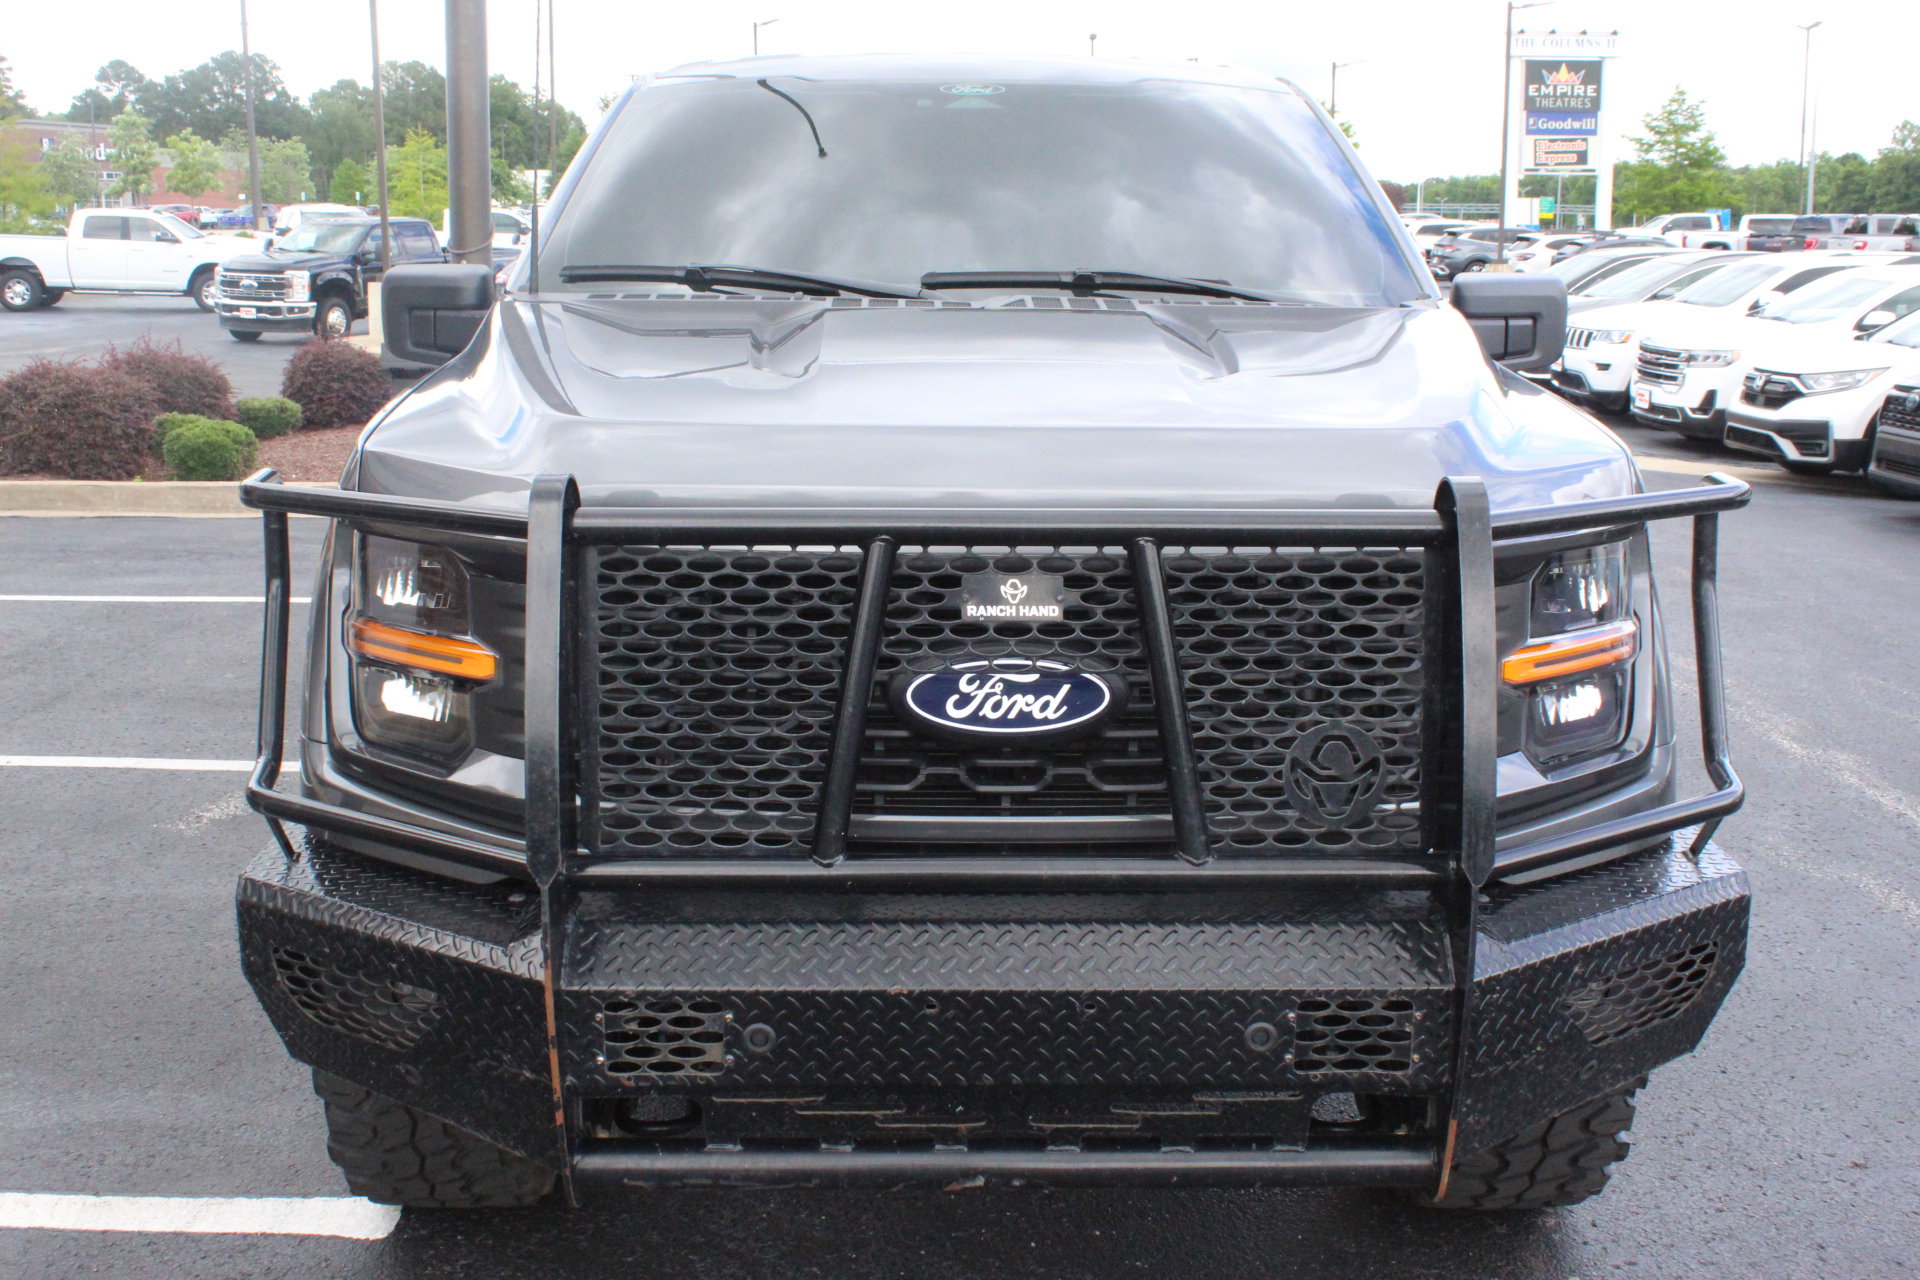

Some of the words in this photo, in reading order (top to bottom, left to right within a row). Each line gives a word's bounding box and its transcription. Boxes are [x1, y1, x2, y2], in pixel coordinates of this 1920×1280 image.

[1514, 38, 1535, 48] THE
[1542, 38, 1601, 48] COLUMNS
[1528, 85, 1598, 96] EMPIRE
[1536, 98, 1591, 108] THEATRES
[1538, 118, 1596, 130] Goodwill
[1537, 140, 1587, 151] Electronic
[1537, 152, 1578, 164] Express
[967, 605, 1016, 617] RANCH
[1019, 605, 1059, 617] HAND
[945, 673, 1072, 720] Ford
